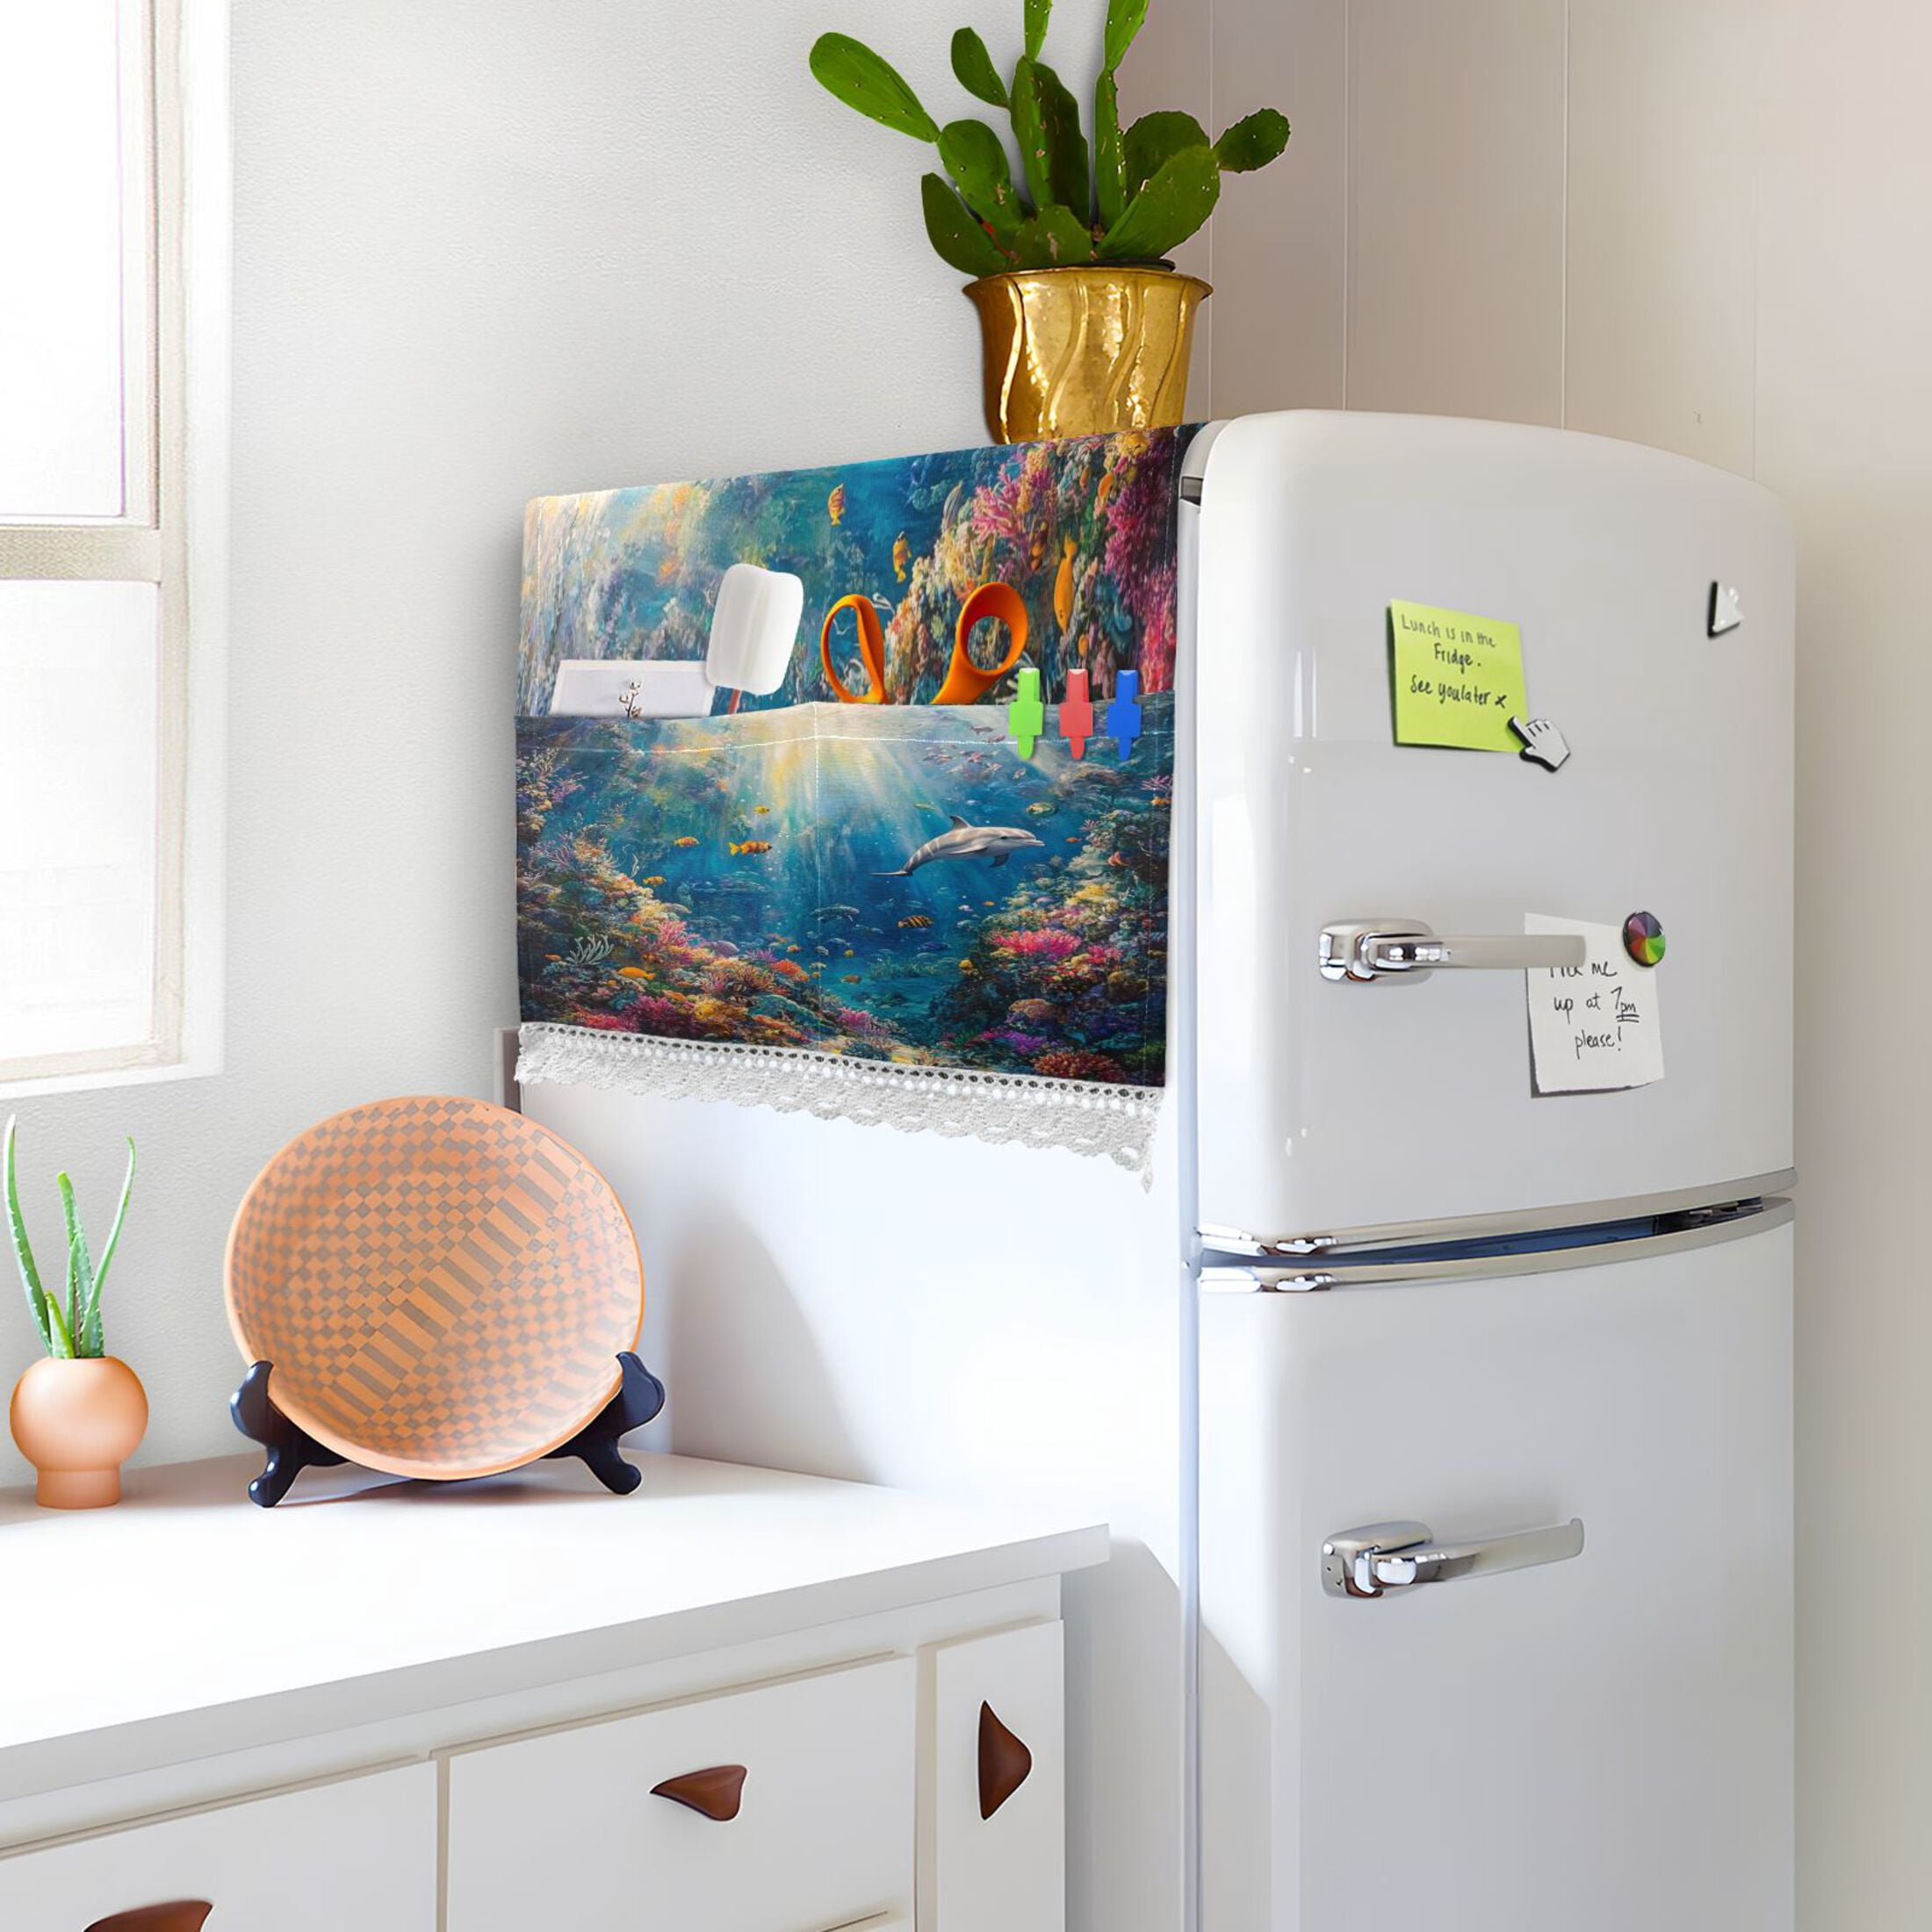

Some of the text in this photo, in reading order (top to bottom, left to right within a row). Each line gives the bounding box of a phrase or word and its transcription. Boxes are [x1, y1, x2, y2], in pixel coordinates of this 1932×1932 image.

[1402, 614, 1496, 648] Lunch is in the
[1410, 674, 1433, 694] See
[1591, 961, 1618, 977] me
[1554, 996, 1574, 1025] up
[1586, 991, 1602, 1011] at
[1575, 1026, 1622, 1061] please!
